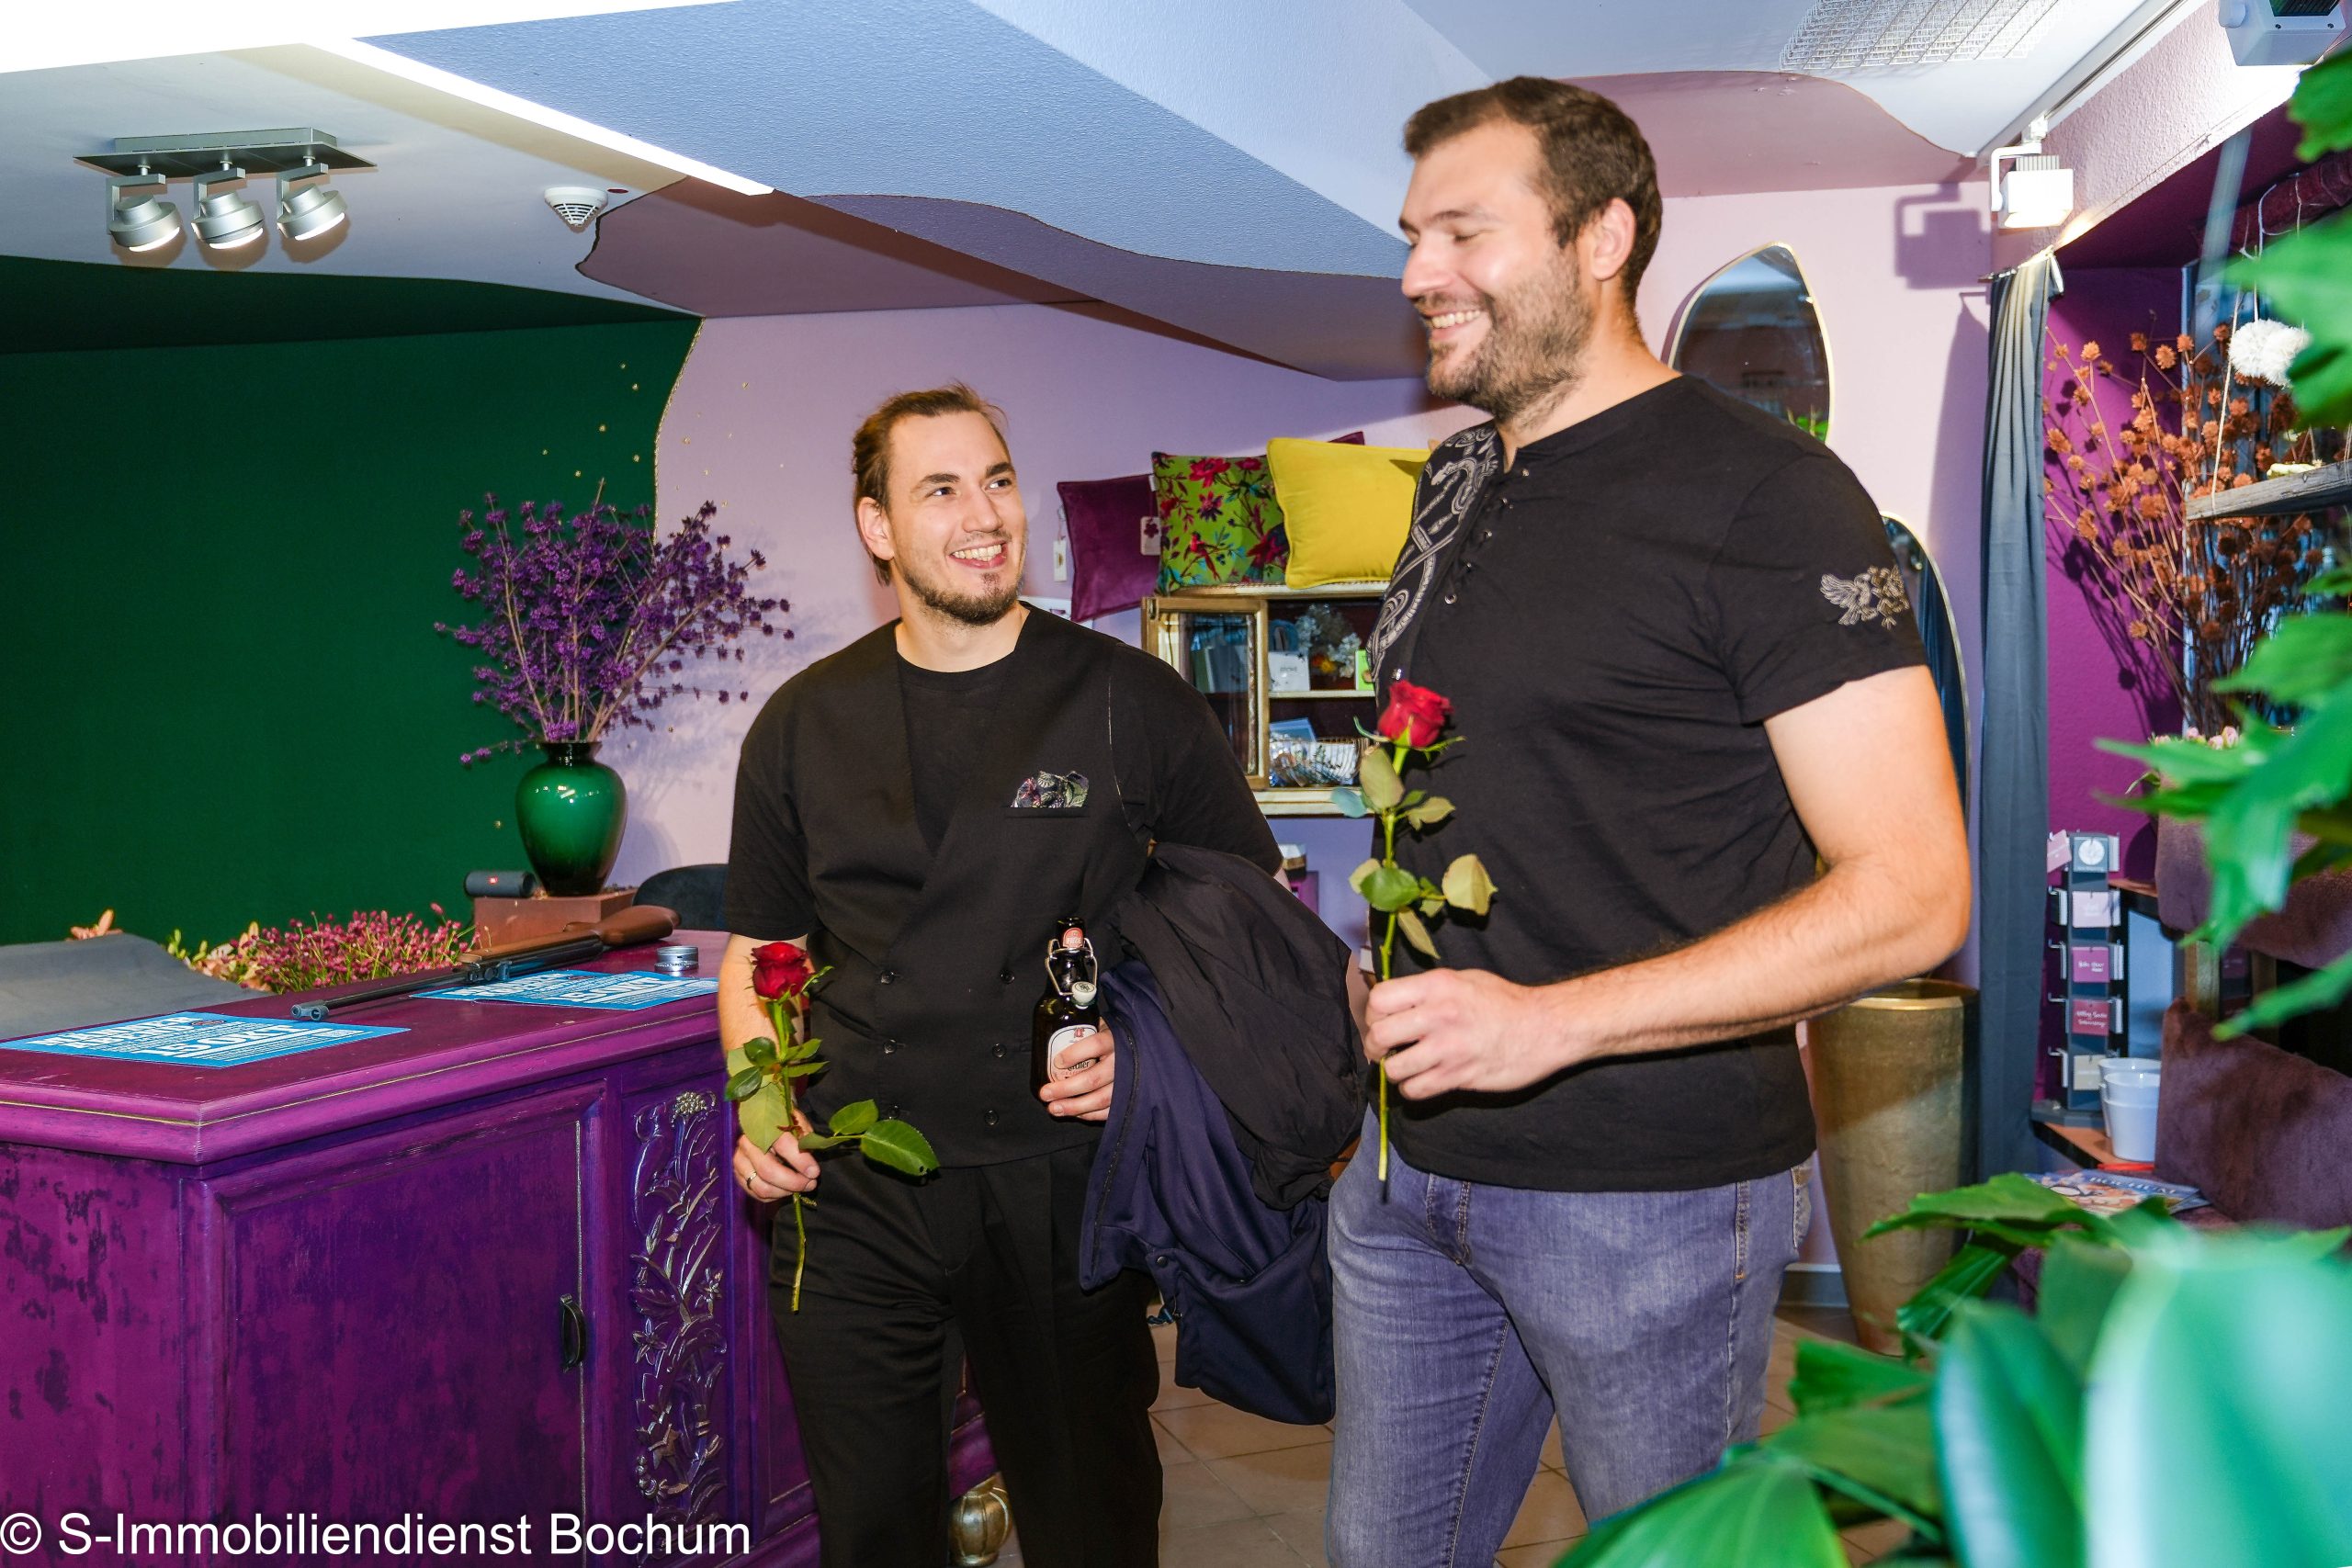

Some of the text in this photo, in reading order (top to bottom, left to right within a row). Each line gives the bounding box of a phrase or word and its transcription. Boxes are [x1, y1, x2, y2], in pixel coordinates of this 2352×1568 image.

[26, 1017, 204, 1045] MÄNNER
[65, 1025, 197, 1048] ABEND
[130, 1043, 212, 1056] 15
[196, 1025, 312, 1044] OKT
